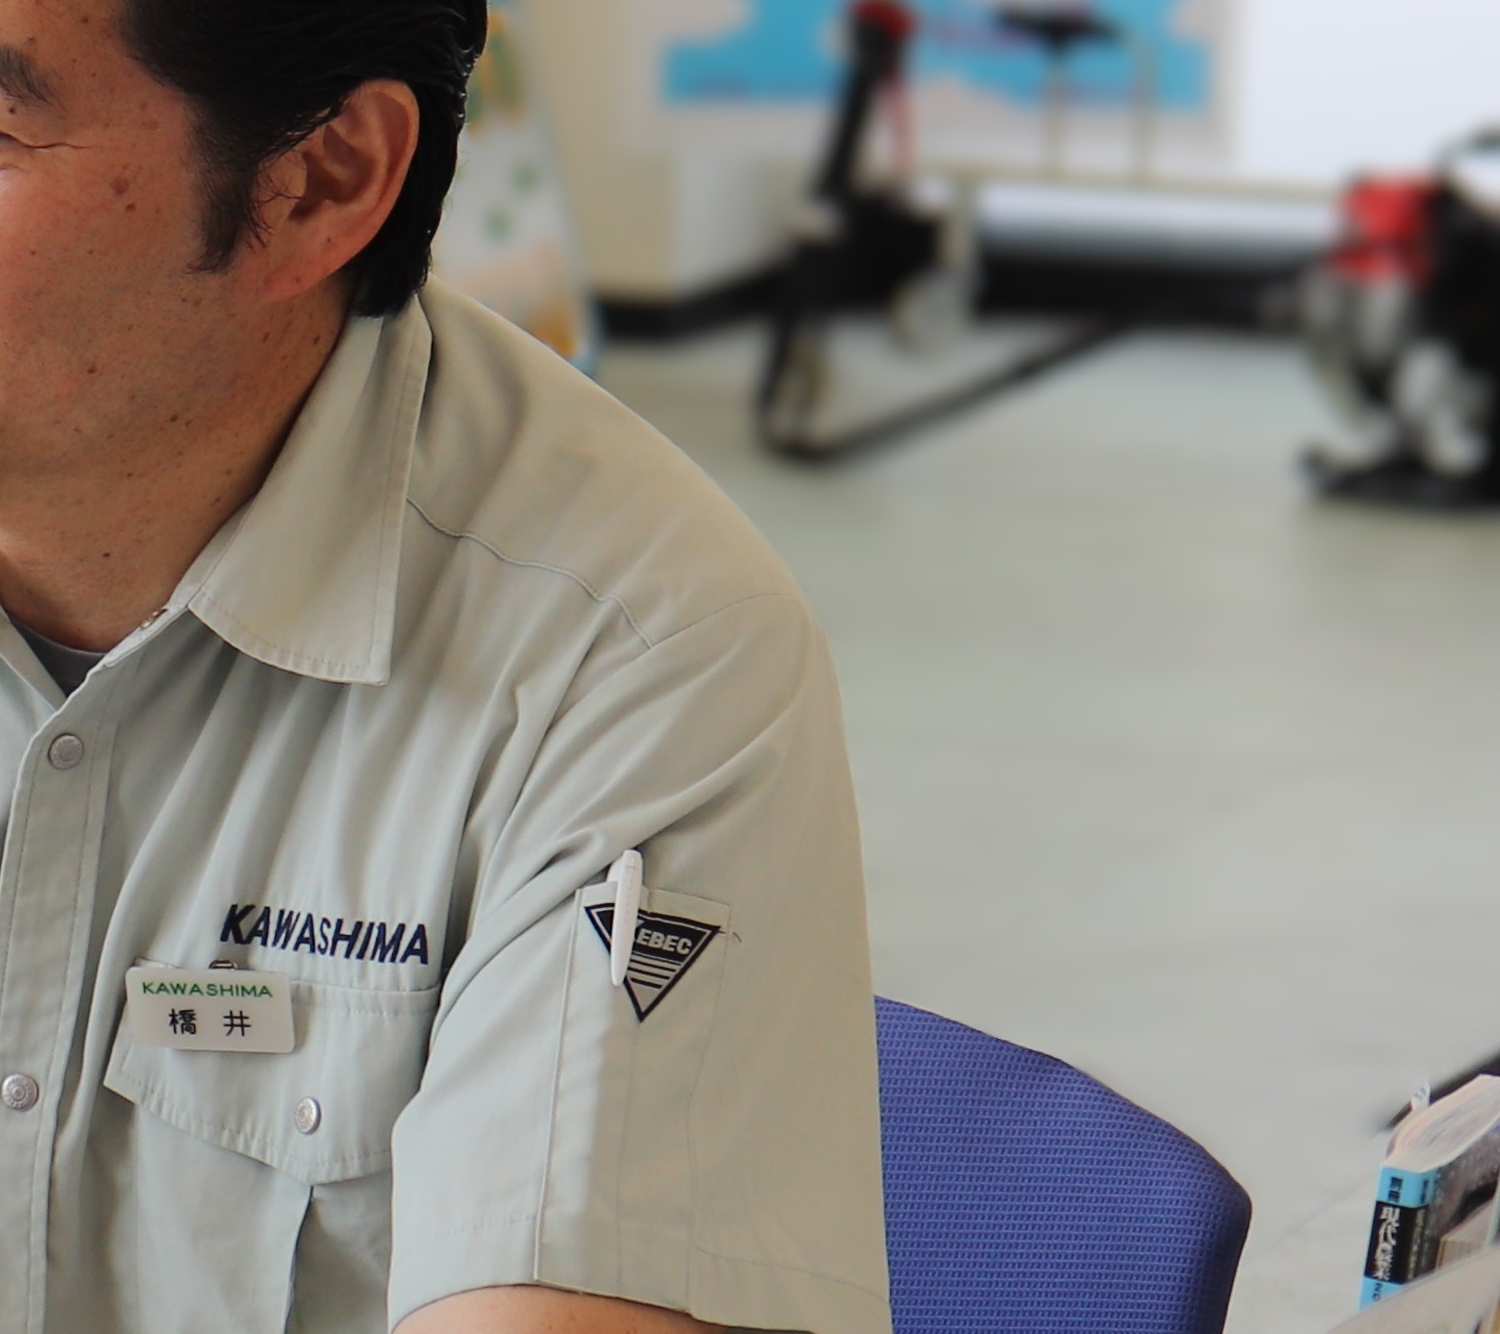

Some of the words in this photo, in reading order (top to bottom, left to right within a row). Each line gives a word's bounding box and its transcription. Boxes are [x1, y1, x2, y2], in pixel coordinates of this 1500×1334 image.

[220, 903, 429, 965] KAWASHIMA
[636, 919, 693, 955] EBEC
[142, 982, 274, 998] KAWASHIMA
